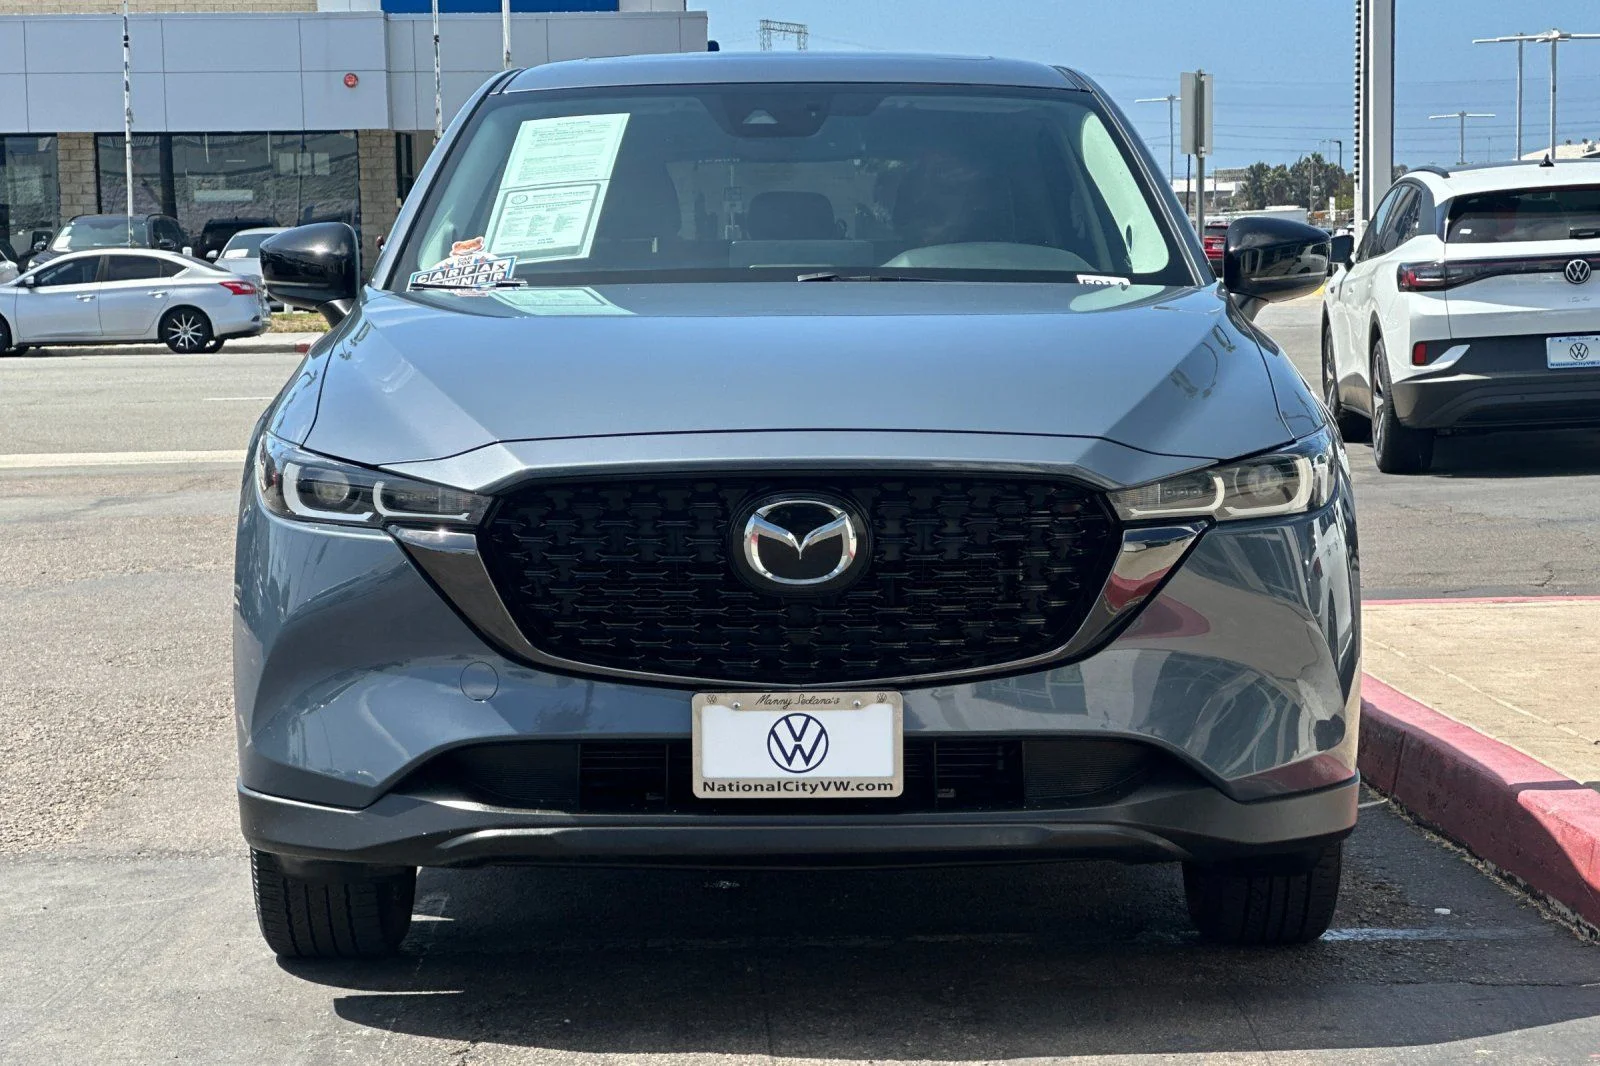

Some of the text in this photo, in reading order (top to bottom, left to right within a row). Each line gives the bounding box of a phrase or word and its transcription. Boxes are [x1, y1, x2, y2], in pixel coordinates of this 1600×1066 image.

[417, 263, 505, 284] CARFAX
[431, 273, 504, 286] WNER
[755, 694, 793, 710] Manny
[703, 781, 894, 794] NationalCityVW.com
